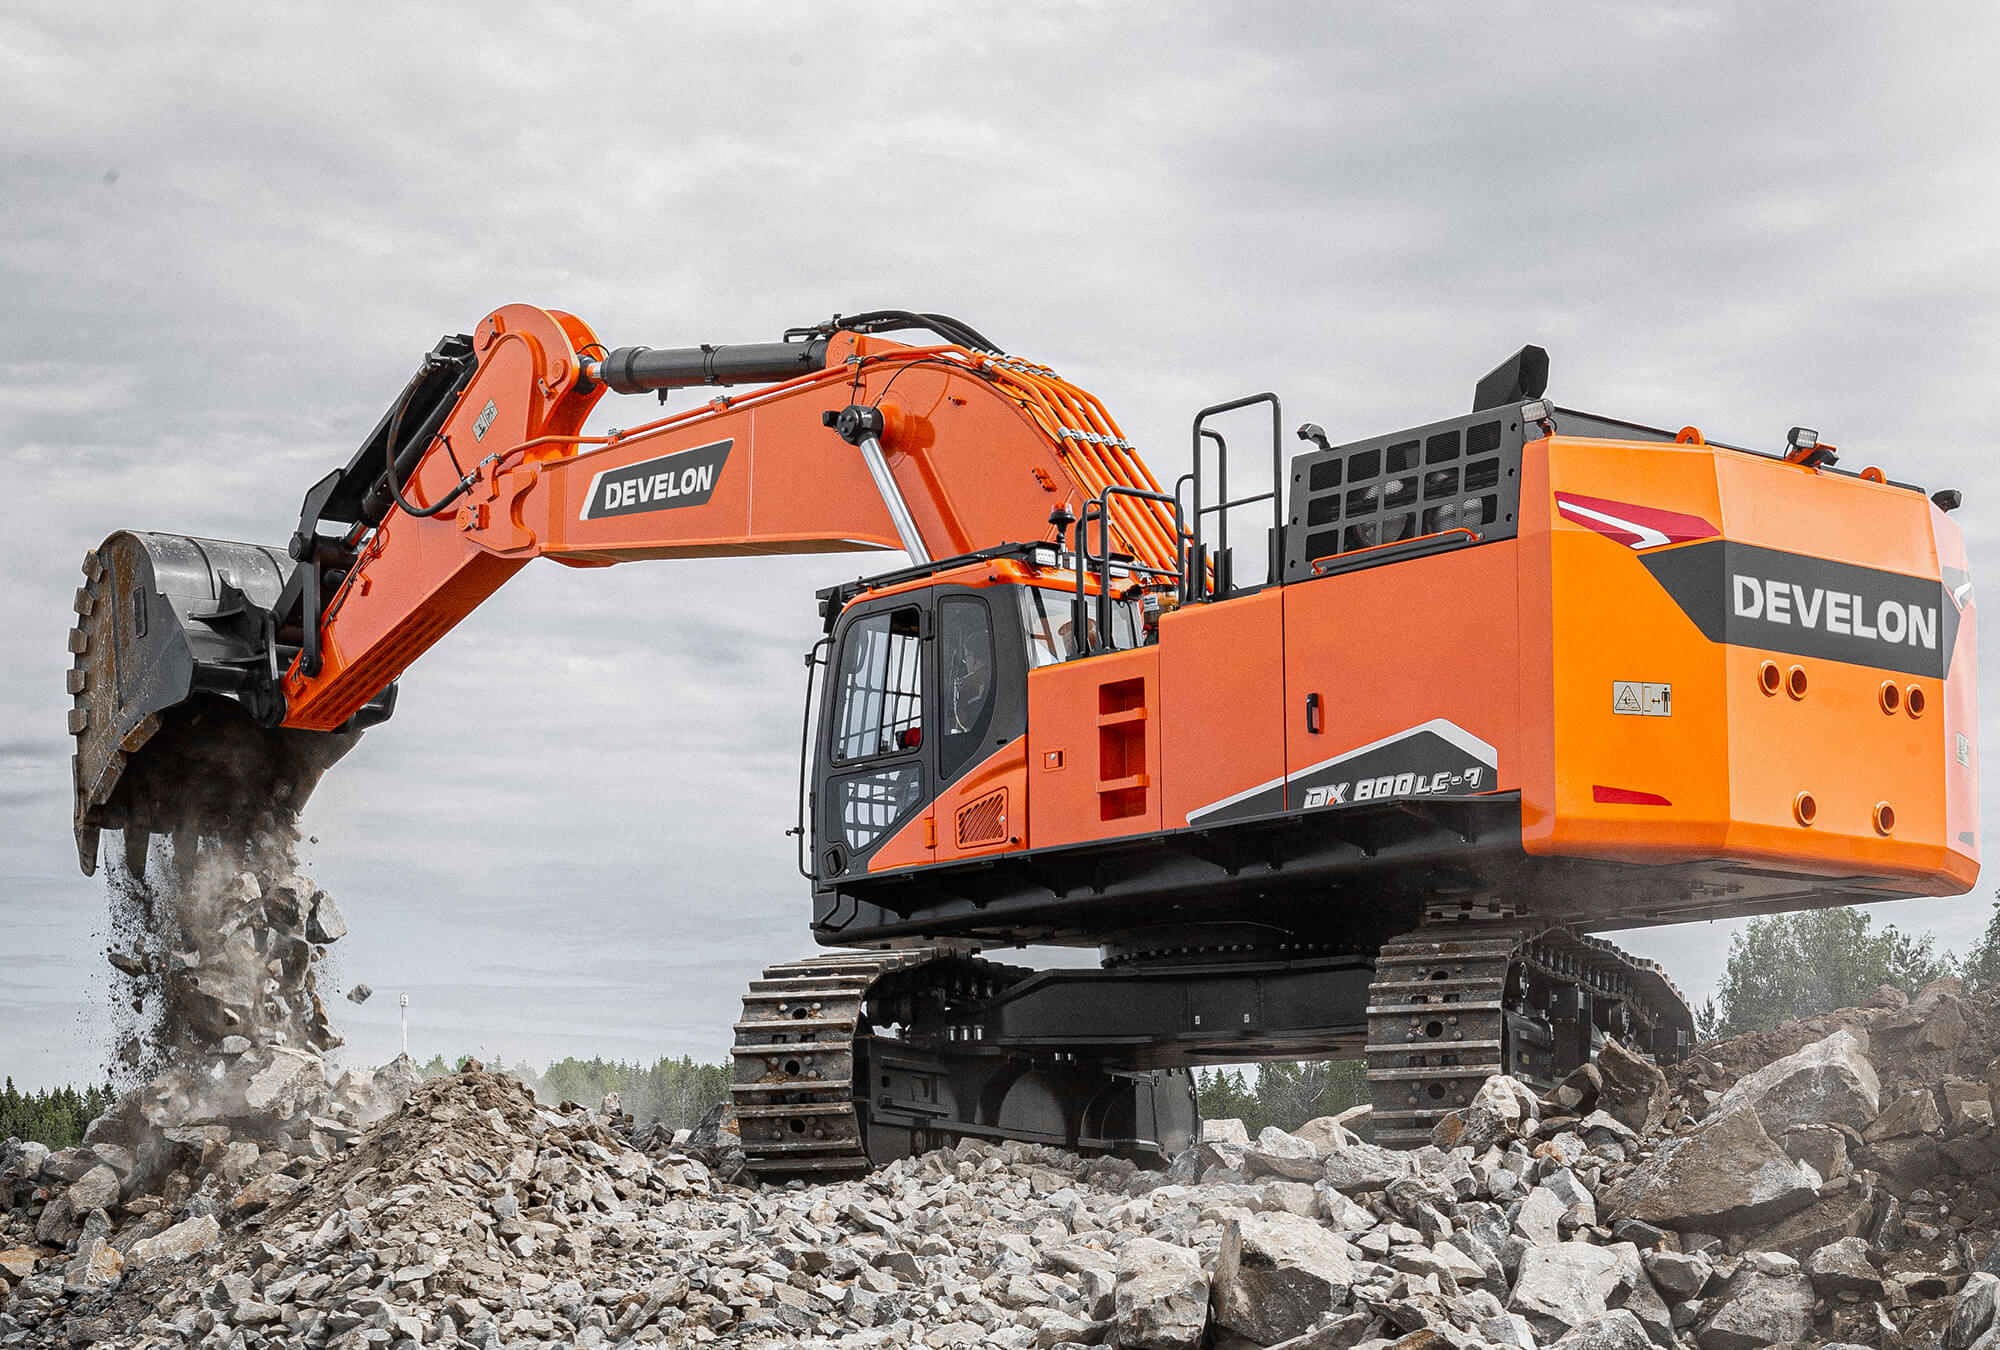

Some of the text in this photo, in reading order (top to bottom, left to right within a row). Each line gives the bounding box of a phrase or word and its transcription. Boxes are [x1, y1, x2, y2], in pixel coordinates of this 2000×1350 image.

[604, 464, 714, 510] DEVELON
[1733, 574, 1936, 650] DEVELON
[1303, 782, 1349, 808] DX
